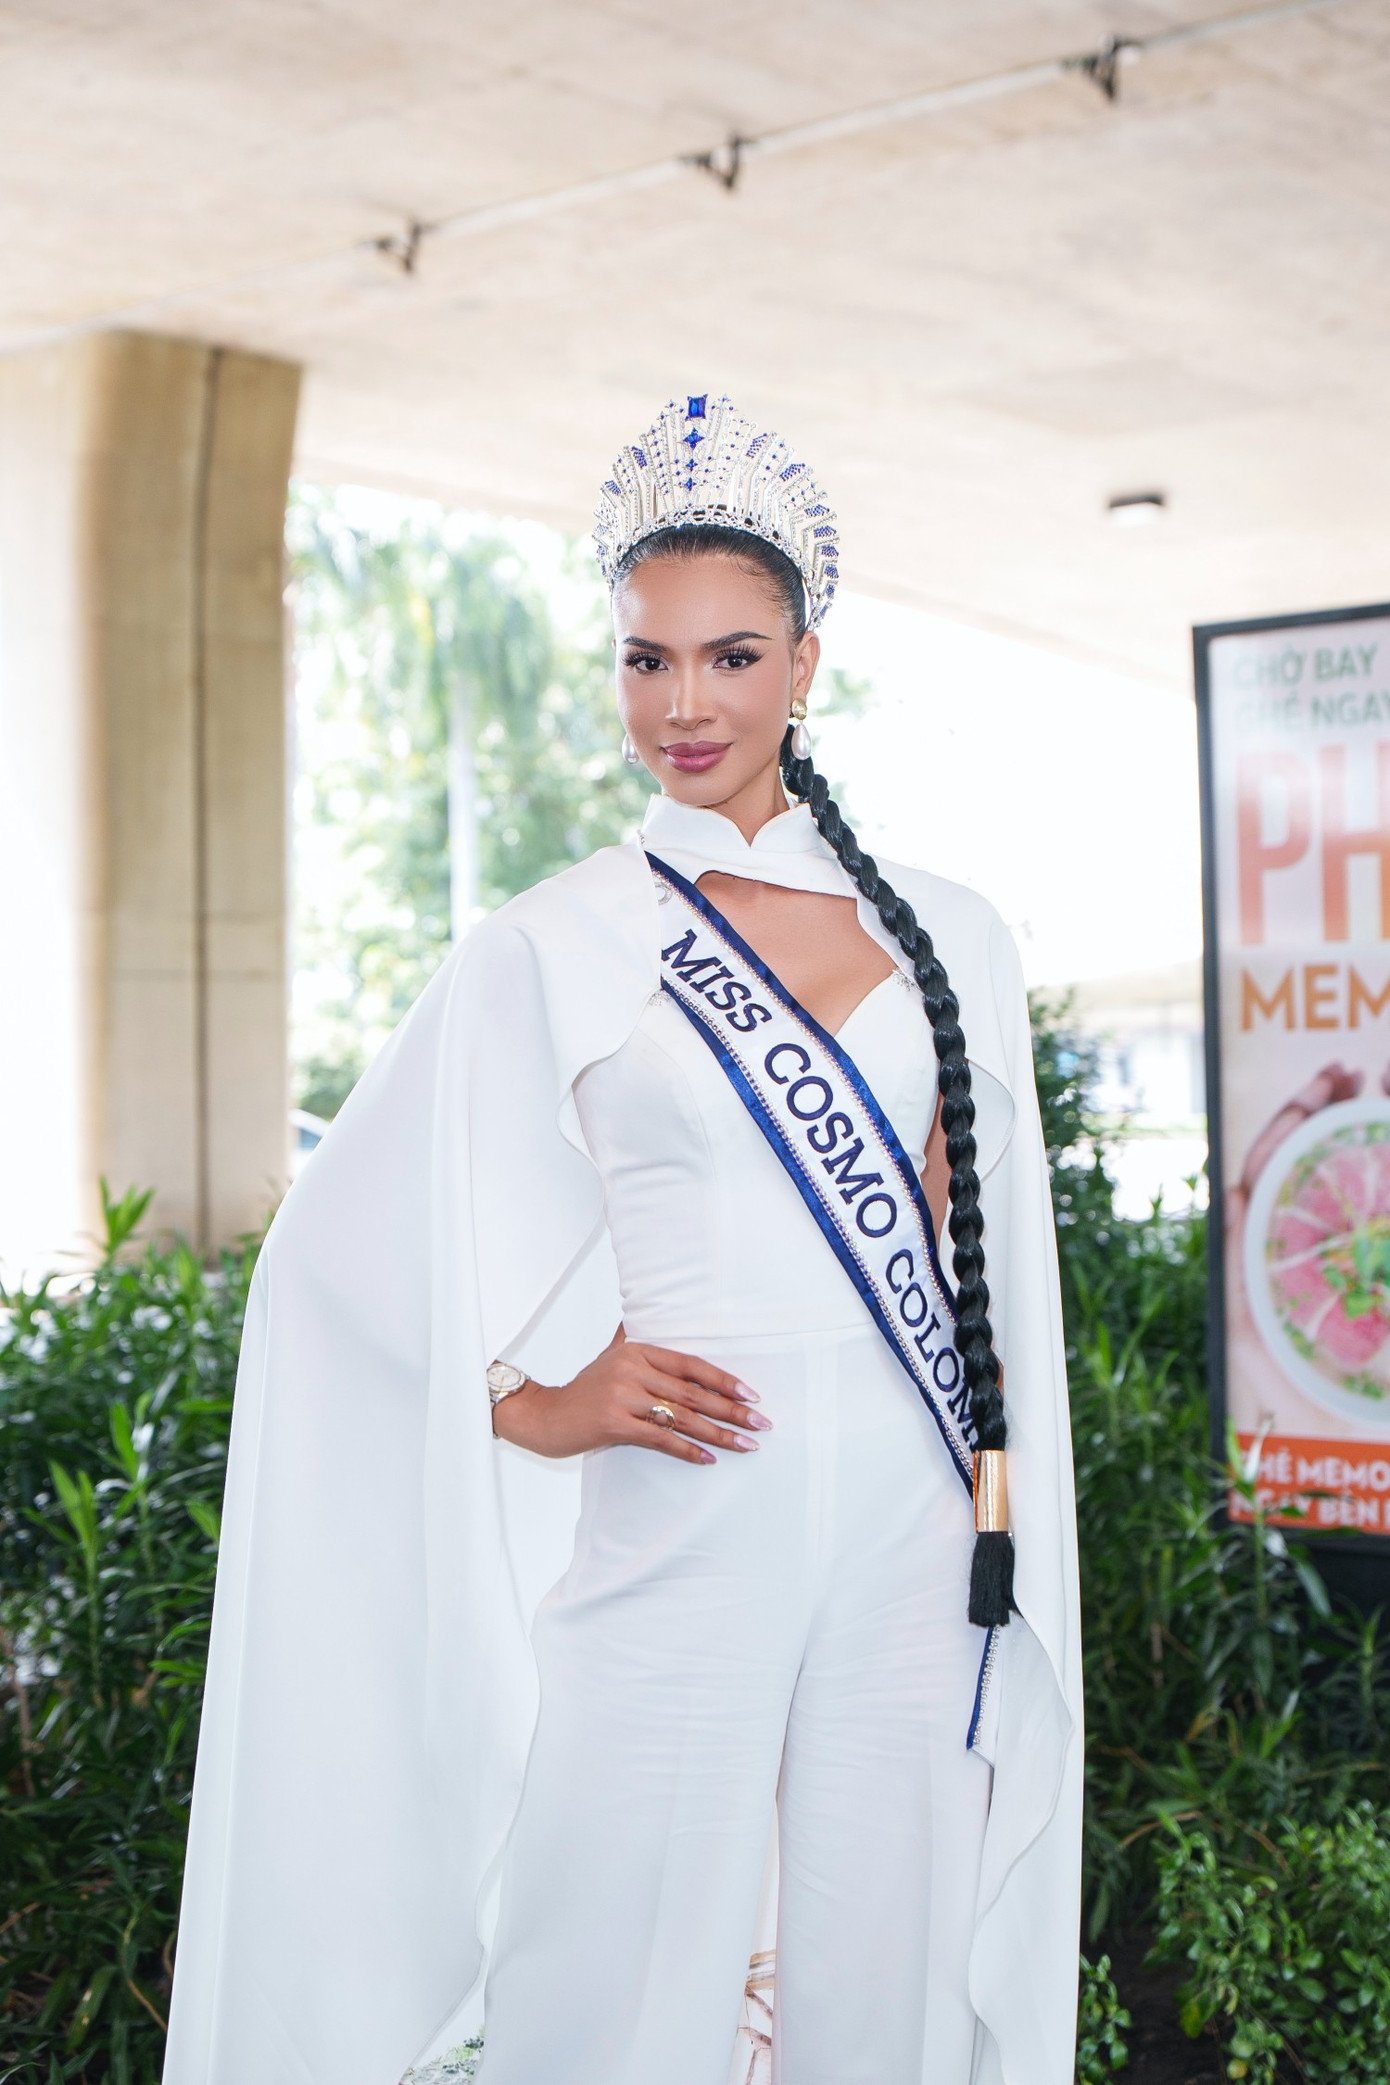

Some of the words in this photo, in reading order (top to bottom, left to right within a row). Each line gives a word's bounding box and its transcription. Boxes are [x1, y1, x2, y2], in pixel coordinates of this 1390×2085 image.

[1314, 641, 1379, 683] BAY
[1240, 965, 1390, 1032] MEM
[661, 929, 772, 1032] MISS
[764, 1043, 897, 1238] COSMO
[886, 1249, 978, 1451] COLOM
[1240, 1447, 1292, 1484] HÉ
[1297, 1457, 1390, 1491] MEMO
